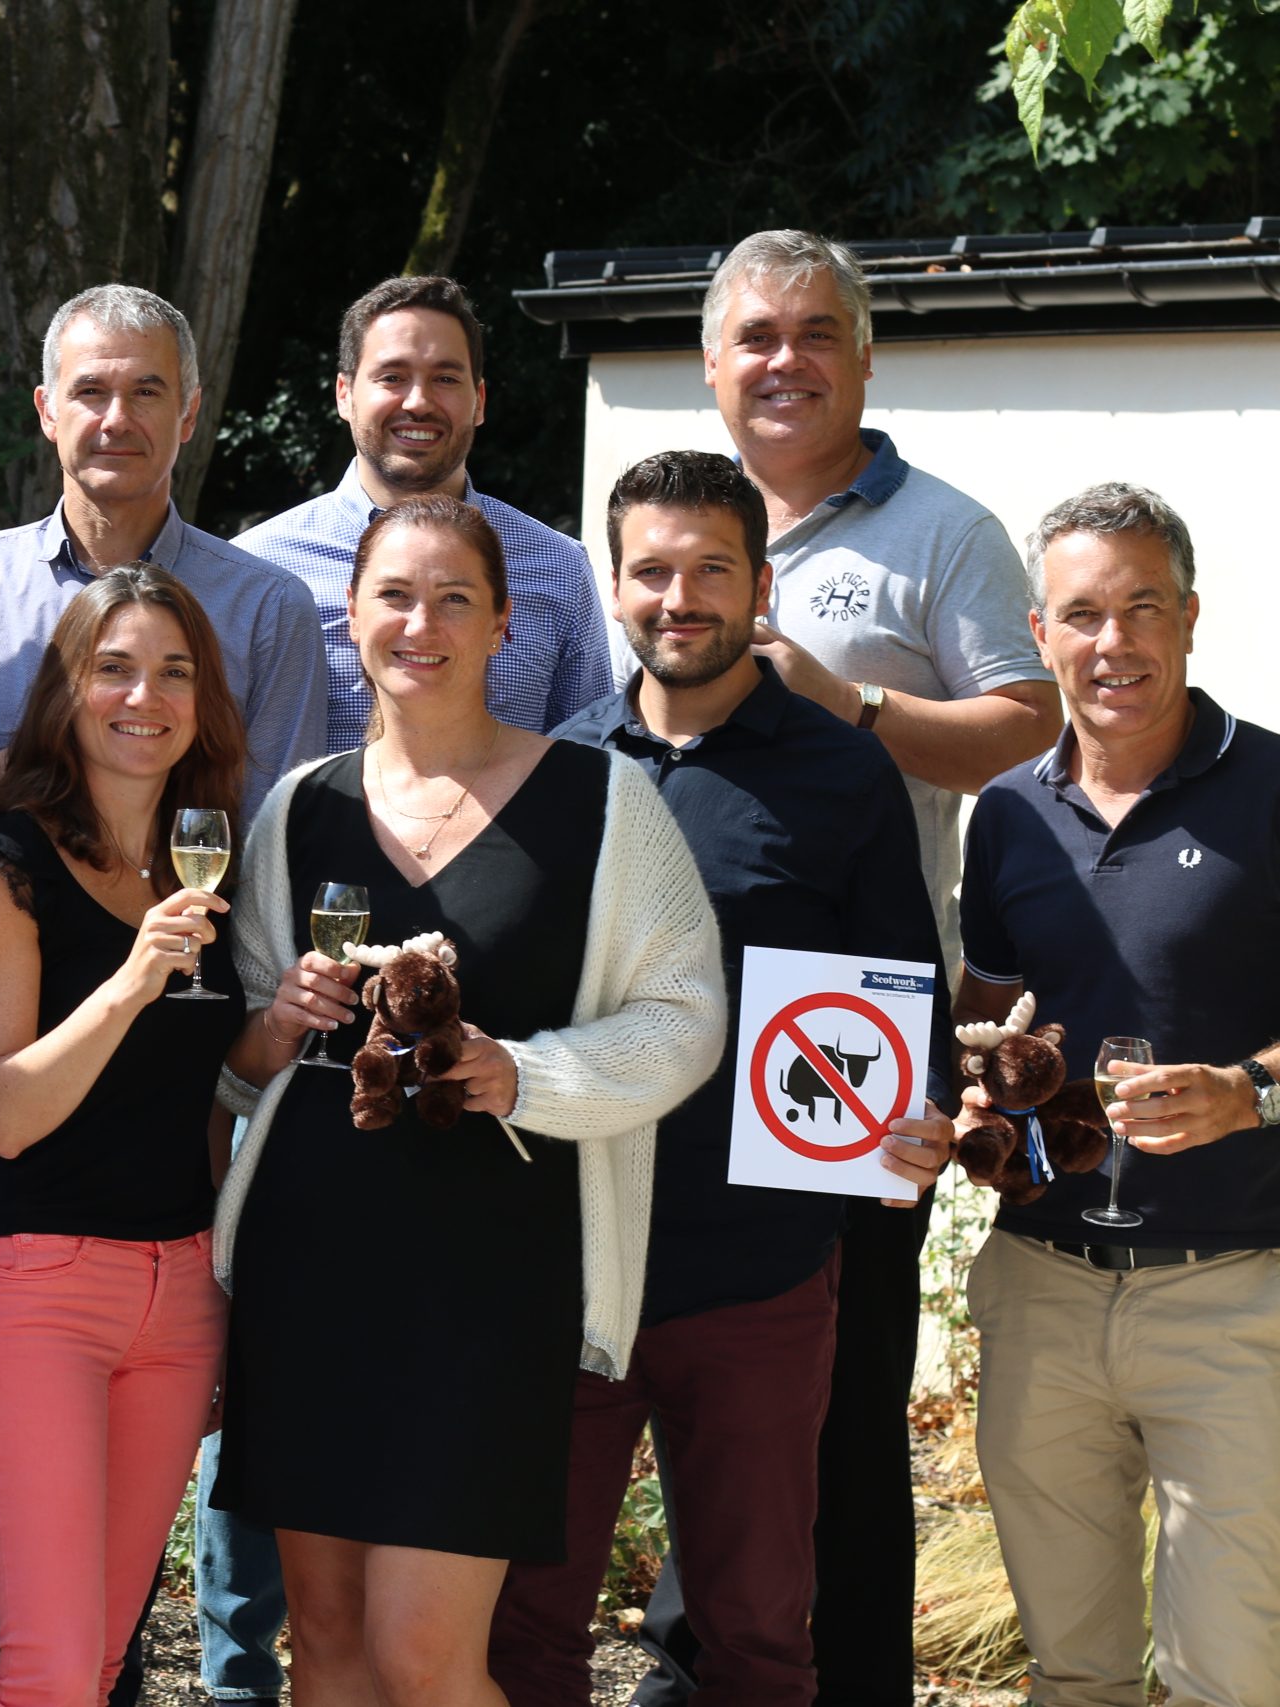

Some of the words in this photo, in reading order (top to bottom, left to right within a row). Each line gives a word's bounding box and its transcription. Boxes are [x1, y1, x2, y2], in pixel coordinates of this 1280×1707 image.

[817, 572, 870, 597] HILFIGER
[826, 588, 854, 607] H
[810, 596, 830, 619] NEW
[832, 600, 869, 622] YORK
[871, 974, 917, 987] Scotwork
